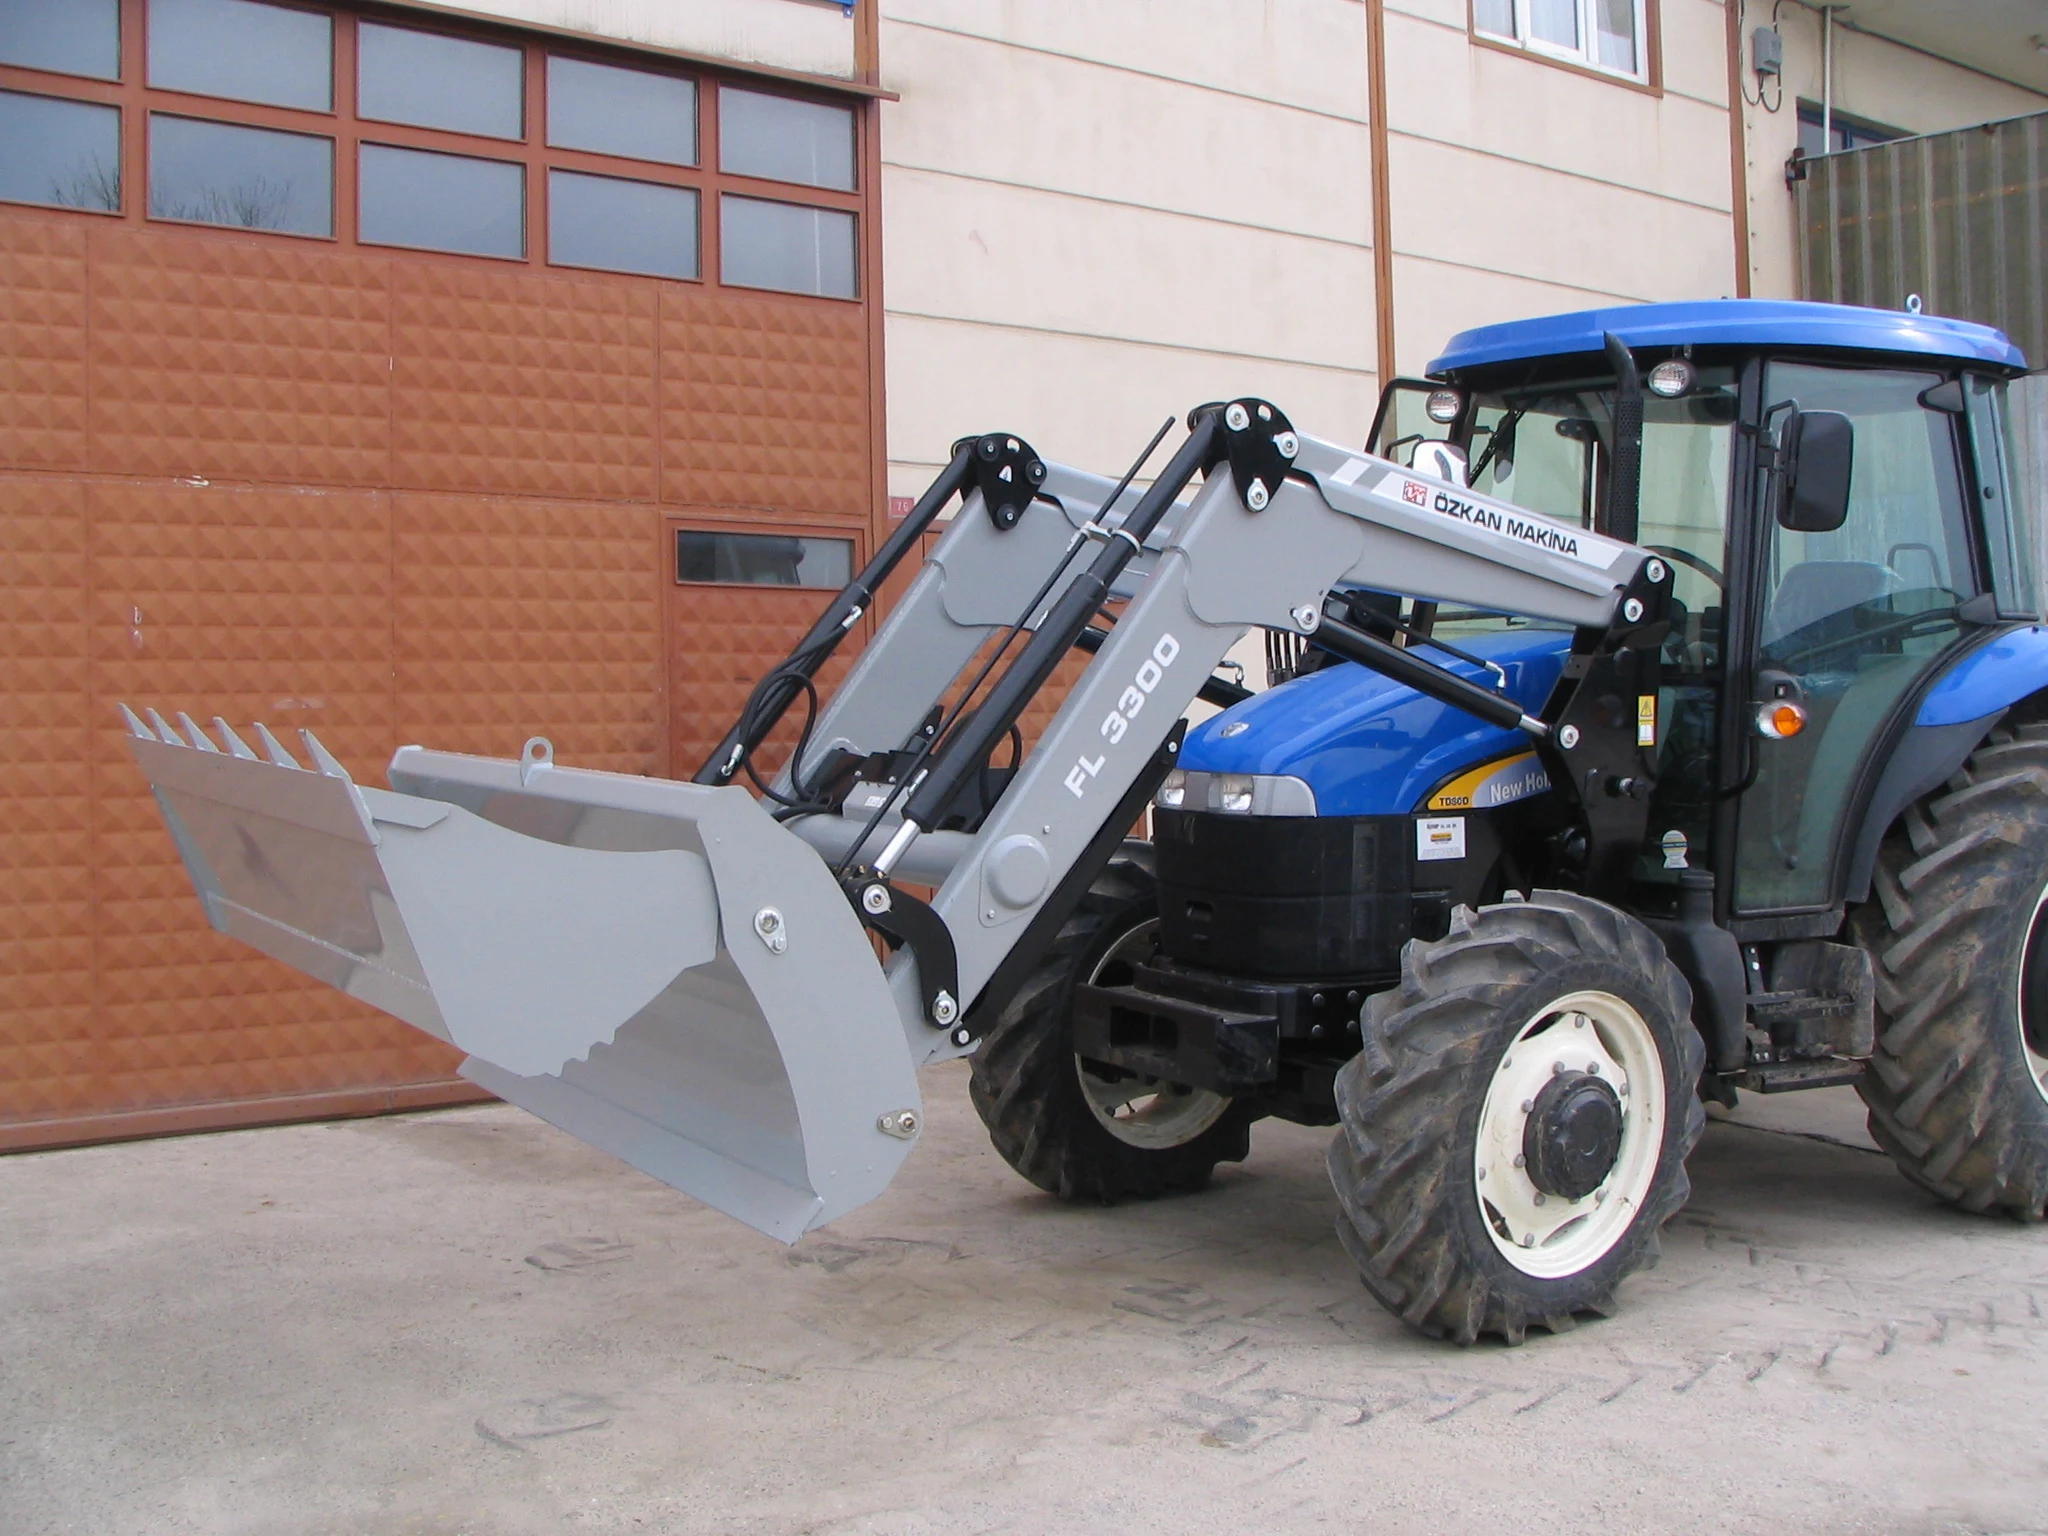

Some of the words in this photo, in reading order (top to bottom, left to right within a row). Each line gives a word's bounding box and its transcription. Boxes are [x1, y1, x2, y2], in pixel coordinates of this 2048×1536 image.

[1434, 491, 1502, 531] ÖZKAN
[1506, 518, 1578, 557] MAKİNA
[1064, 755, 1106, 799] FL
[1100, 633, 1180, 744] 3300
[1490, 782, 1522, 803] New
[1525, 770, 1551, 792] Hol
